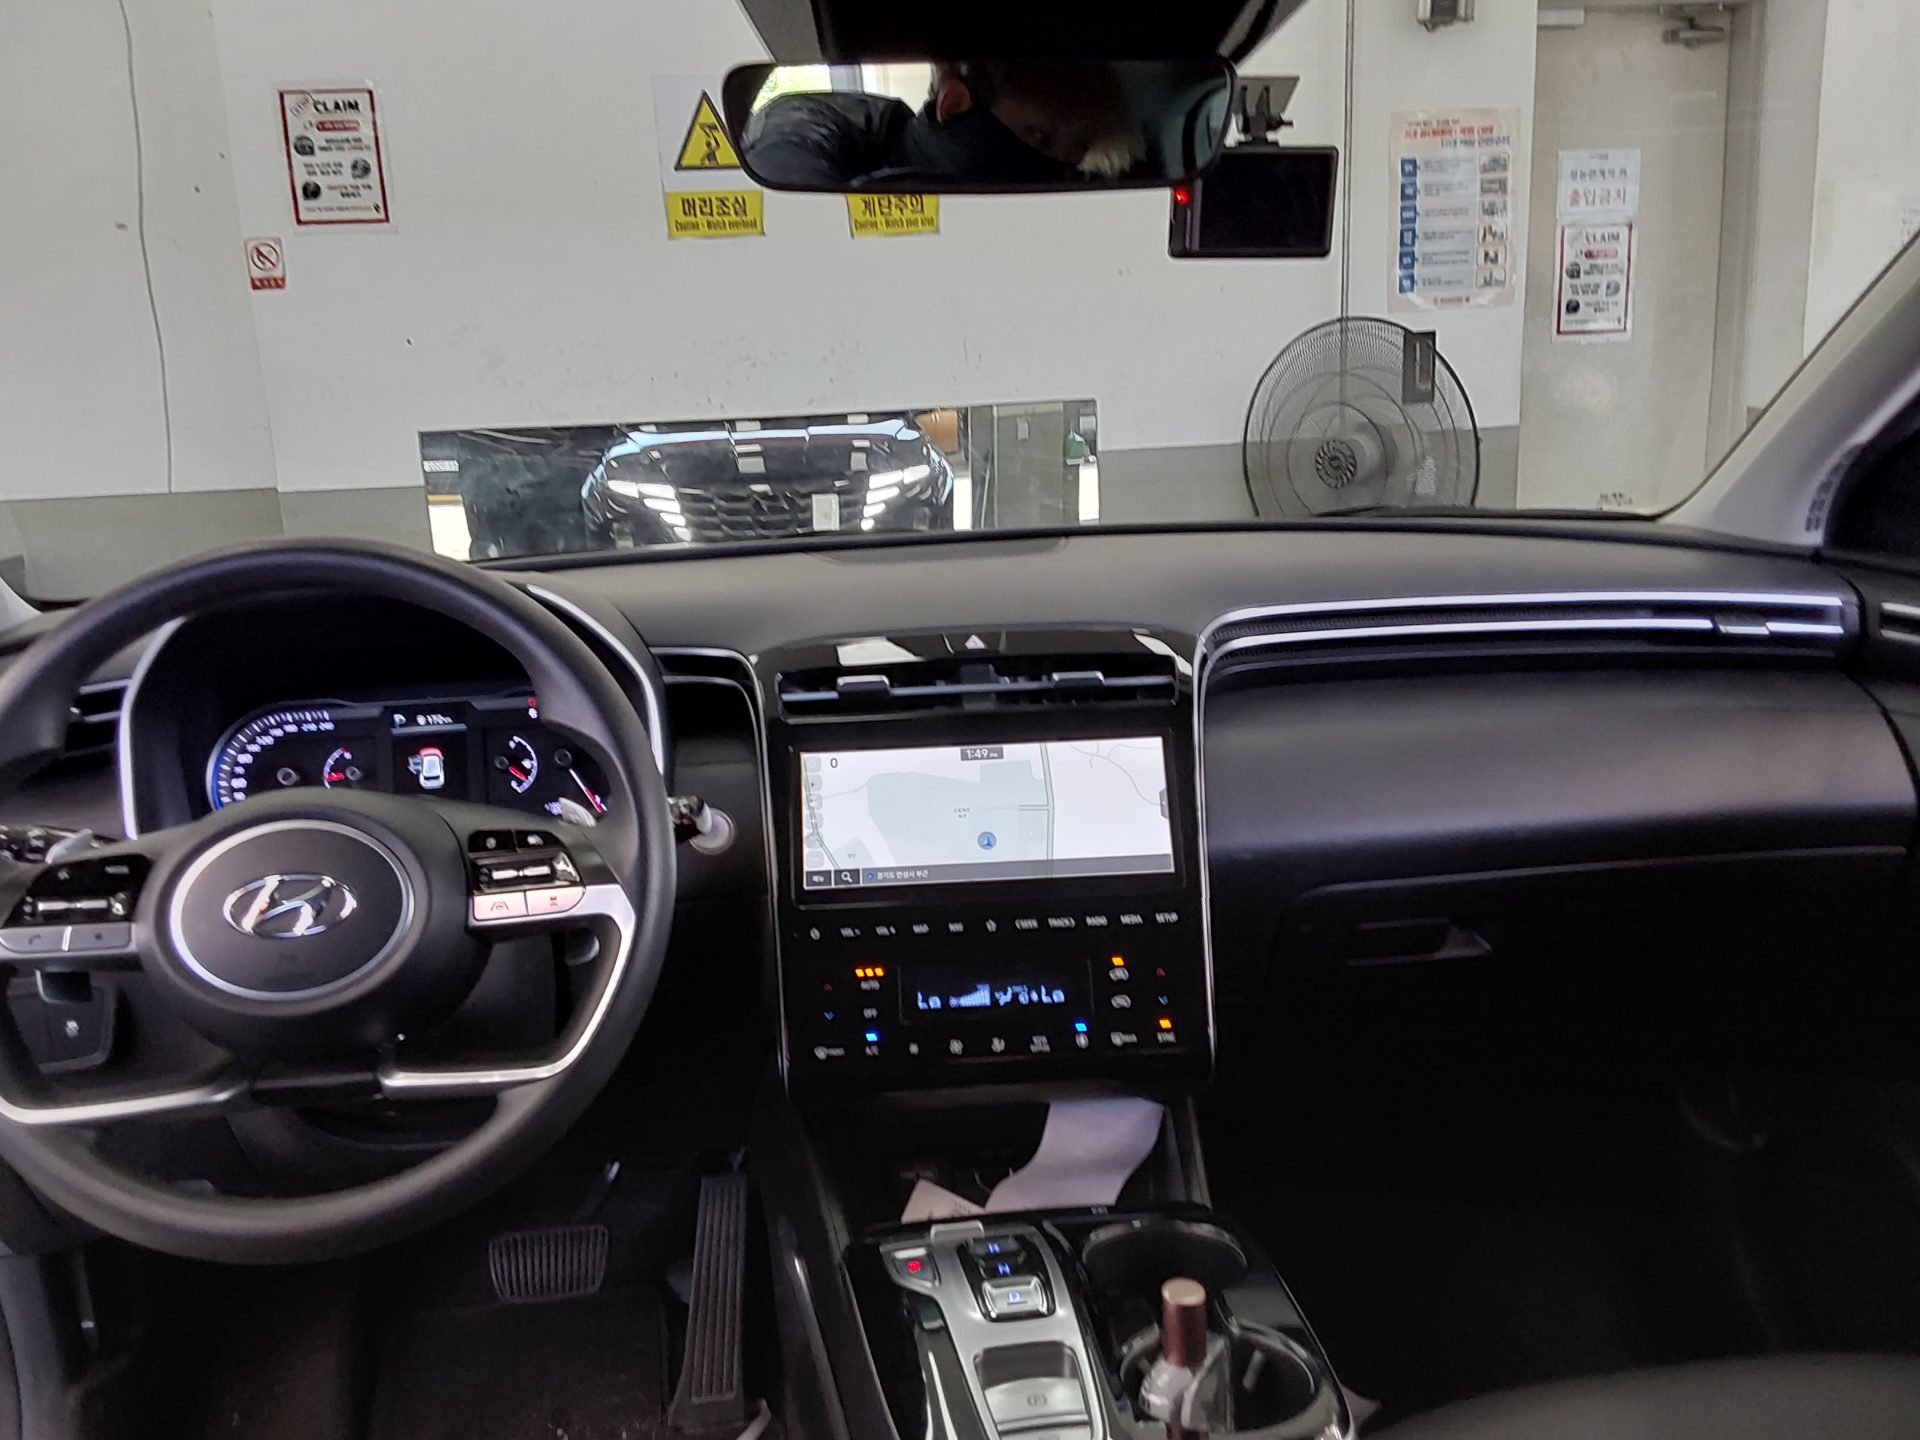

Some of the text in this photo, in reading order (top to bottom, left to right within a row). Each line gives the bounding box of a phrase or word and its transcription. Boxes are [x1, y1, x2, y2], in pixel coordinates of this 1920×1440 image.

[313, 100, 360, 113] CLAIM
[681, 196, 747, 218] 머리조심
[861, 193, 925, 217] 계단주의
[966, 749, 988, 759] 1:49
